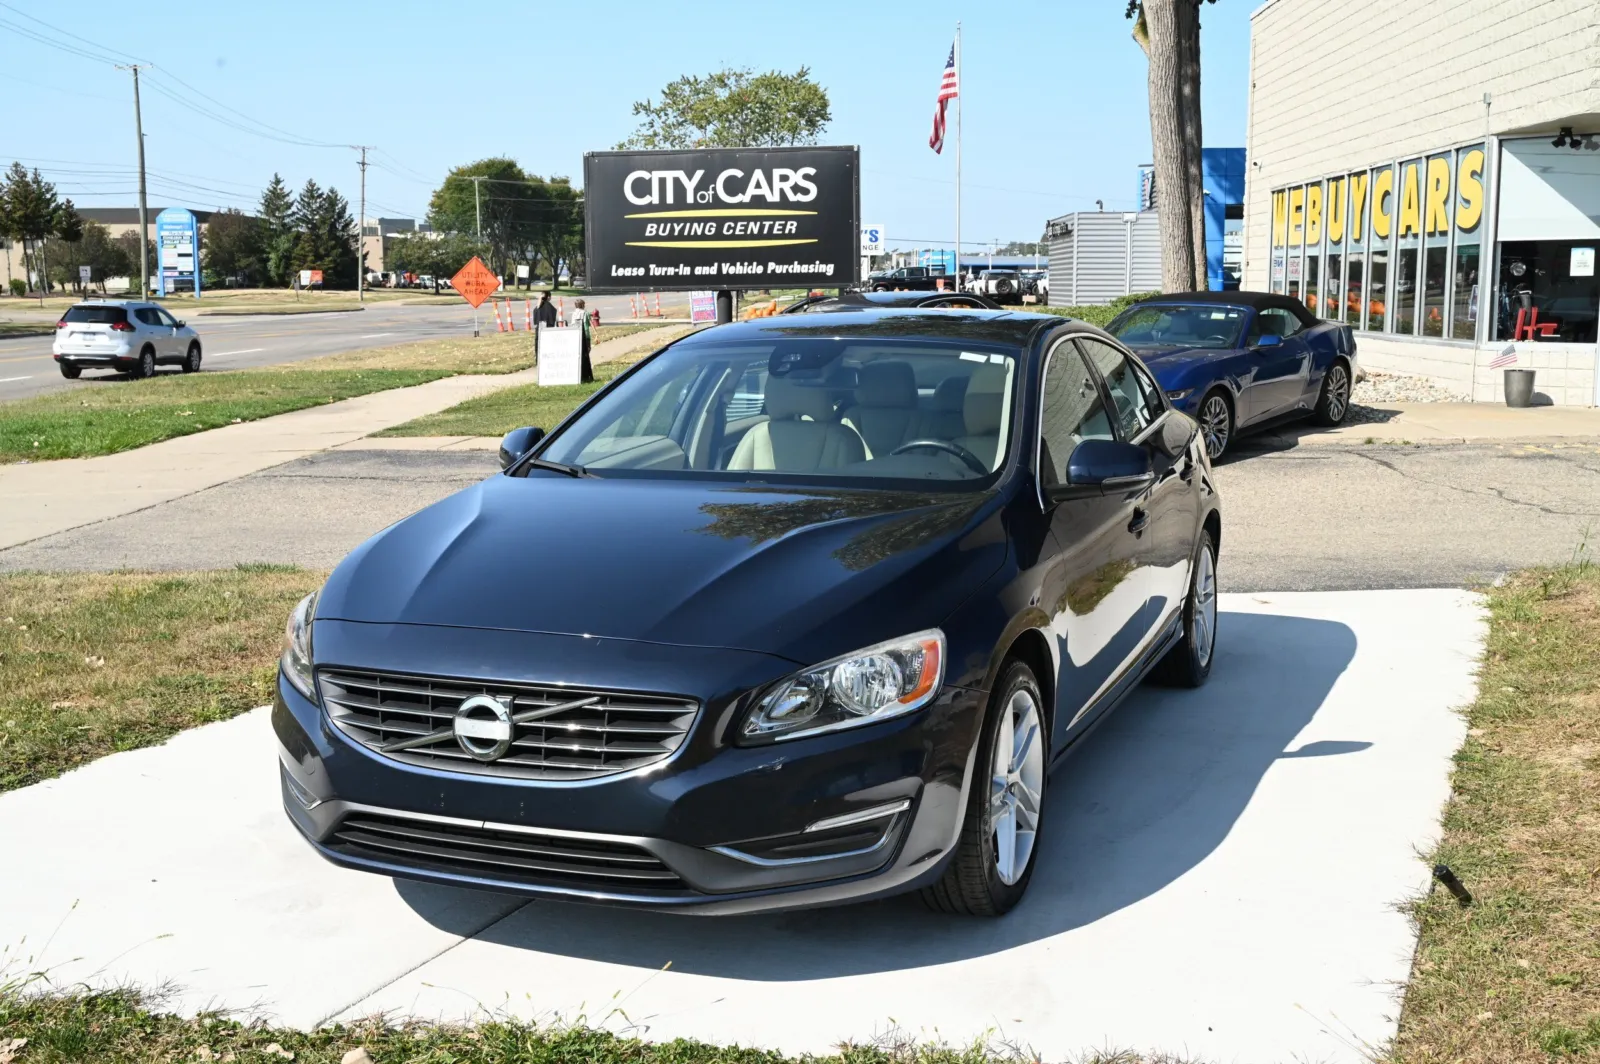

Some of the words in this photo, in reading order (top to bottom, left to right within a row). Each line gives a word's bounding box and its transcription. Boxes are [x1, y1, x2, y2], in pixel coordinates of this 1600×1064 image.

[624, 168, 705, 206] CITY
[696, 184, 716, 204] of
[715, 166, 818, 204] CARS
[644, 221, 717, 237] BUYING
[723, 220, 798, 235] CENTER
[861, 229, 879, 243] 'S
[461, 271, 488, 279] UTILITY
[611, 263, 645, 277] Lease
[649, 262, 691, 276] Turn-In
[694, 262, 718, 275] and
[721, 261, 764, 275] Vehicle
[767, 260, 835, 277] Purchasing
